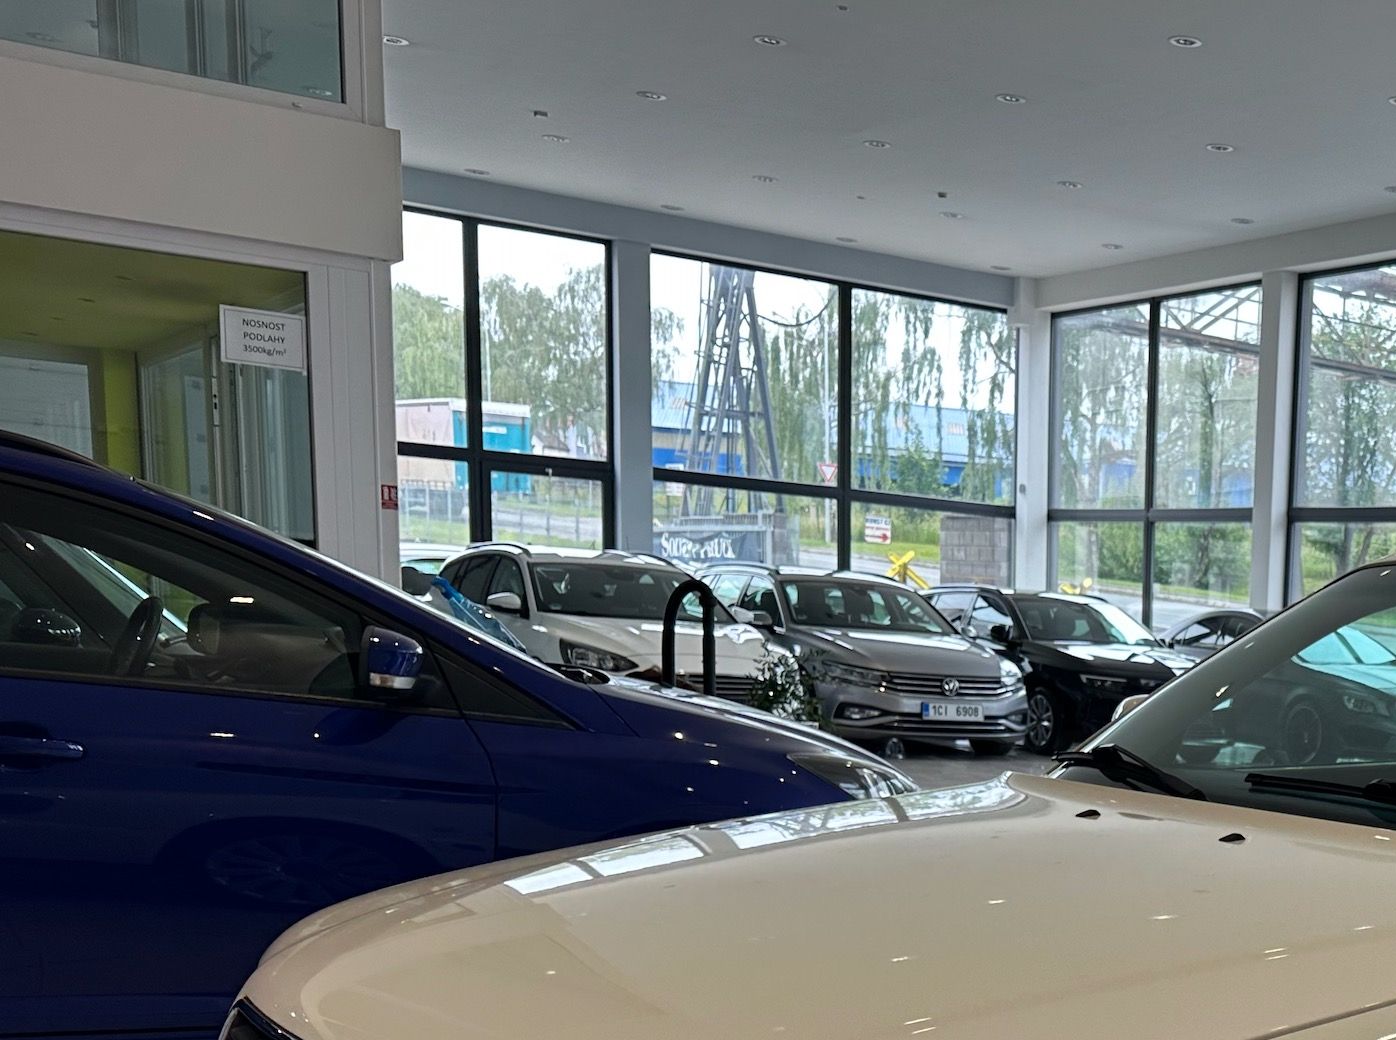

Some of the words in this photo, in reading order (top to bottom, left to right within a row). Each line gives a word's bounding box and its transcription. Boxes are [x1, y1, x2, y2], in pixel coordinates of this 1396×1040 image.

[242, 318, 286, 331] NOSNOST
[243, 331, 286, 344] PODLAHY
[932, 705, 948, 716] 1CI
[956, 706, 979, 718] 6908
